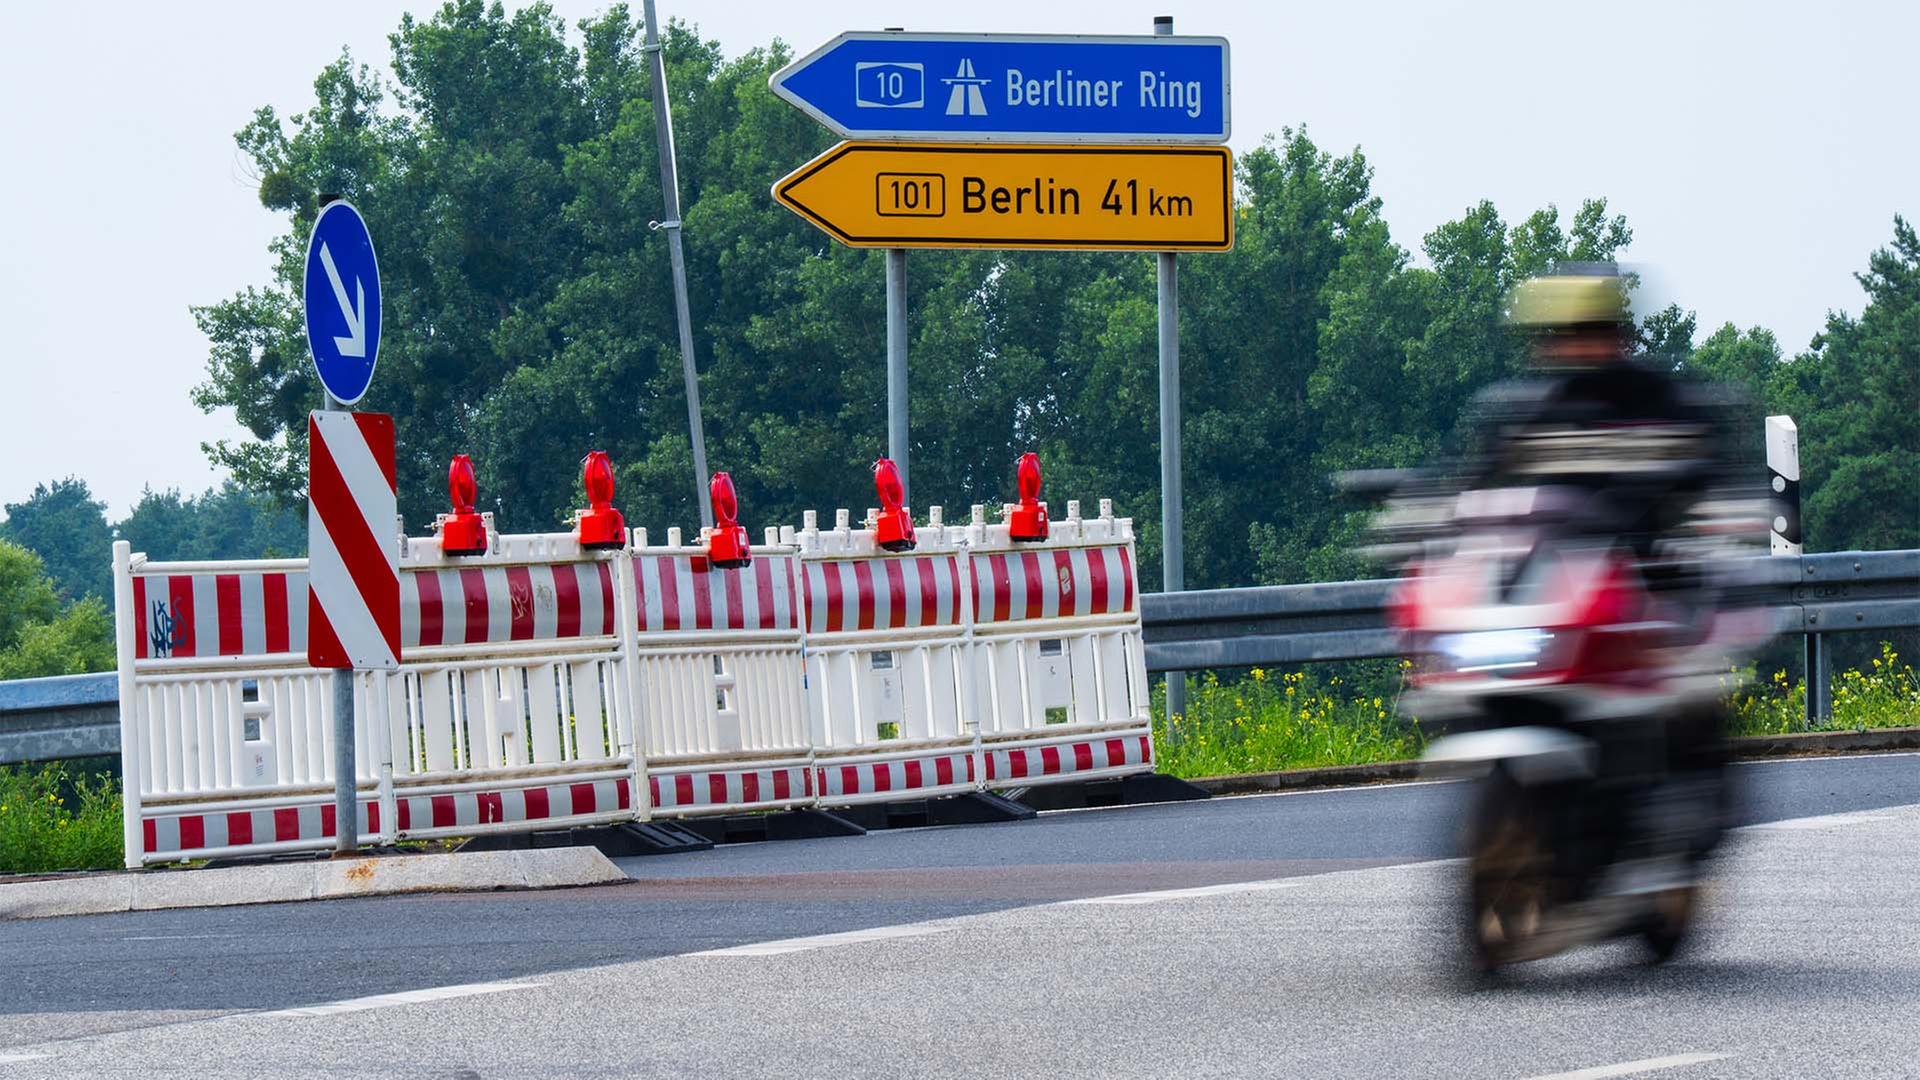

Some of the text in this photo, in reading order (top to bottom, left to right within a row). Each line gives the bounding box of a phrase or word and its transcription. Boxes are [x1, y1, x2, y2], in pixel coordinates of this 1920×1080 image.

[876, 72, 903, 100] 10
[1006, 69, 1202, 118] Berliner Ring
[890, 180, 931, 209] 101
[962, 176, 1193, 217] Berlin 41 km
